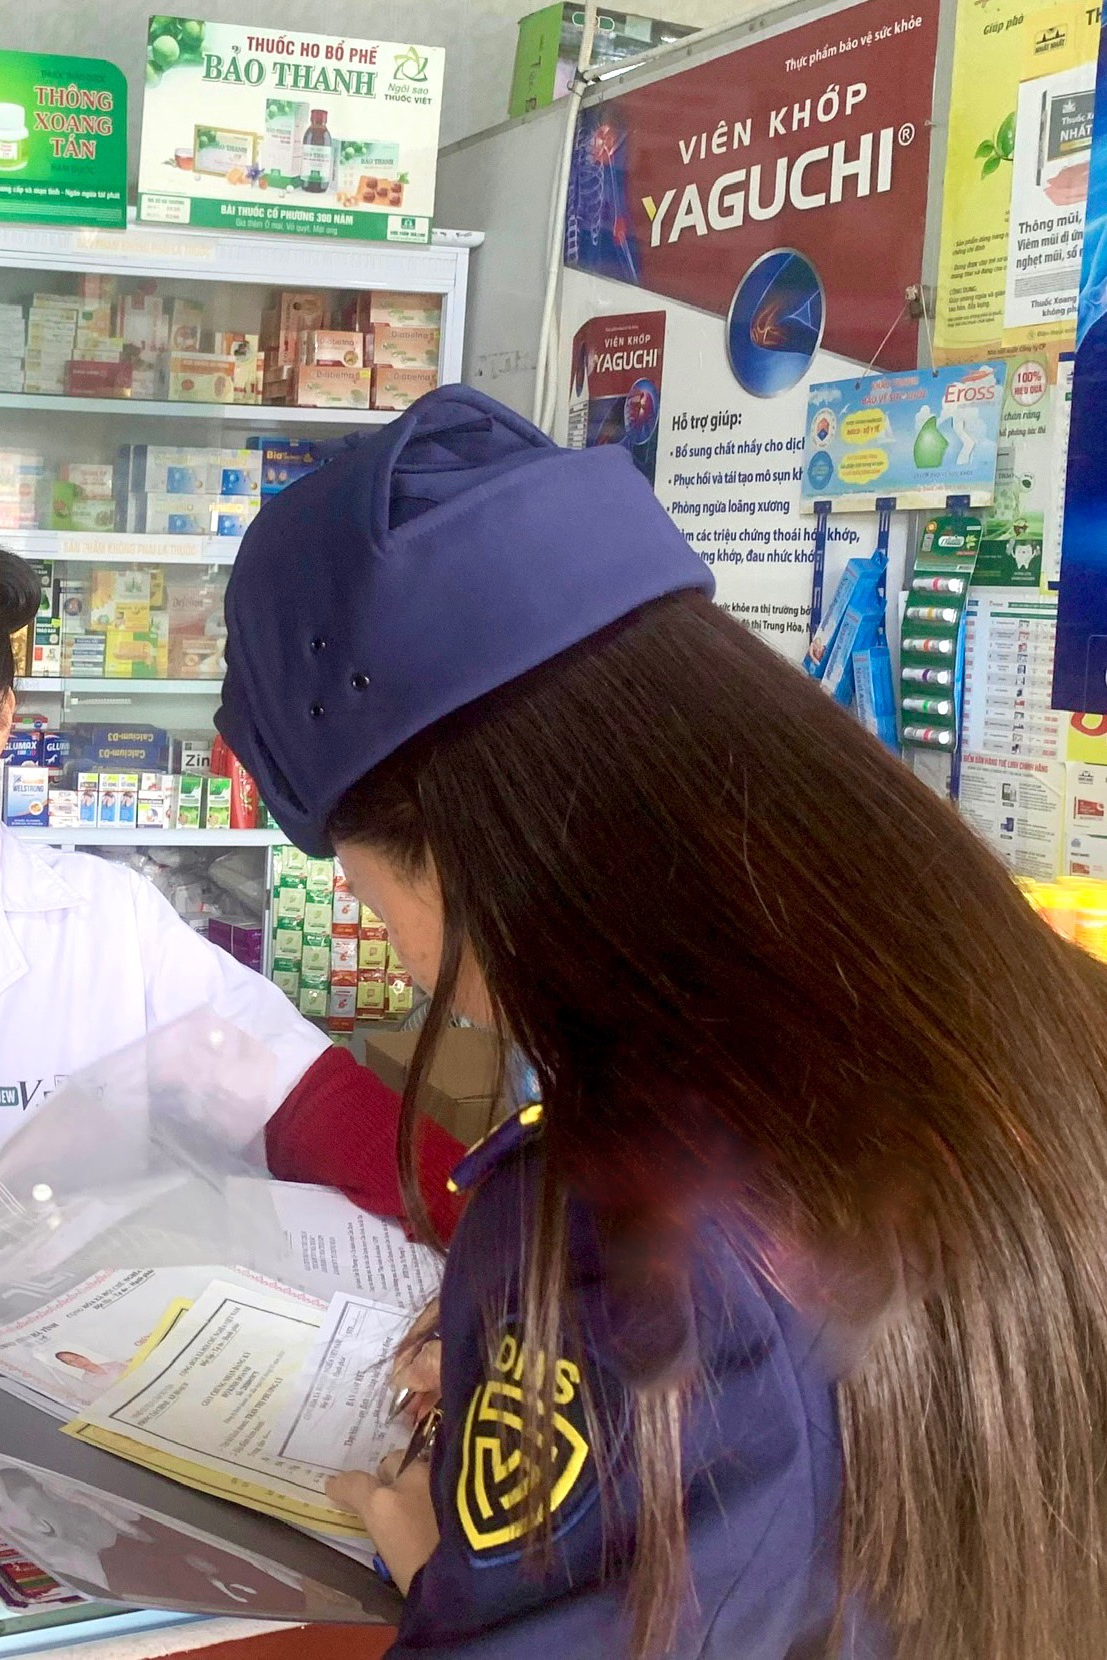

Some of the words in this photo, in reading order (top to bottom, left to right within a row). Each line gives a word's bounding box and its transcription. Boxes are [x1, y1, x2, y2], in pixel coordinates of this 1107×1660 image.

[983, 21, 1003, 35] Giúp
[247, 34, 295, 56] THUỐC
[300, 42, 320, 58] HO
[325, 40, 345, 61] BỔ
[349, 45, 380, 65] PHẾ
[785, 56, 808, 72] Thực
[809, 43, 837, 67] phẩm
[839, 37, 859, 53] bảo
[860, 30, 873, 47] vệ
[874, 25, 892, 41] sức
[894, 15, 922, 36] khỏe
[202, 46, 266, 85] BẢO
[272, 61, 378, 98] THANH
[34, 83, 113, 111] THÔNG
[388, 82, 411, 94] Ngôi
[413, 86, 429, 95] sao
[384, 94, 413, 104] THUỐC
[414, 95, 432, 106] VIỆT
[34, 112, 113, 135] XOANG
[677, 116, 752, 166] VIÊN
[768, 80, 868, 138] KHỚP
[1062, 112, 1086, 125] Thuốc
[50, 134, 96, 159] TÁN
[220, 203, 236, 216] BÀI
[237, 205, 265, 219] THUỐC
[267, 206, 279, 219] CỔ
[280, 208, 314, 222] PHƯƠNG
[316, 213, 332, 223] 300
[333, 213, 354, 226] NĂM
[1019, 216, 1053, 234] Thông
[1057, 211, 1082, 228] mũi,
[1017, 236, 1039, 251] Viêm
[1041, 232, 1059, 247] mũi
[1016, 255, 1042, 271] nghẹt
[1044, 250, 1065, 264] mũi,
[1031, 296, 1052, 309] Thuốc
[604, 335, 625, 348] VIÊN
[627, 332, 651, 346] KHỚP
[594, 348, 658, 374] YAGUCHI
[1017, 372, 1042, 383] 100%
[944, 384, 995, 403] Eross
[672, 411, 688, 432] Hỗ
[690, 413, 709, 432] trợ
[710, 411, 742, 431] giúp:
[675, 443, 689, 459] Bổ
[690, 445, 713, 461] sung
[714, 438, 735, 457] chất
[764, 439, 784, 453] cho
[673, 470, 695, 489] Phục
[696, 468, 711, 485] hồi
[712, 470, 723, 485] và
[724, 467, 740, 485] tái
[740, 471, 754, 489] tạo
[755, 467, 771, 483] mô
[773, 471, 791, 489] sụn
[671, 499, 700, 516] Phòng
[701, 501, 727, 518] ngừa
[728, 499, 756, 515] loãng
[757, 499, 790, 516] xương
[696, 529, 712, 542] các
[713, 528, 737, 543] triệu
[738, 528, 771, 546] chứng
[773, 526, 802, 543] thoái
[827, 526, 860, 546] khớp,
[717, 548, 744, 567] khớp,
[746, 549, 765, 563] đau
[766, 547, 793, 563] nhức
[732, 602, 750, 614] khỏe
[751, 605, 759, 614] ra
[760, 603, 772, 616] thị
[773, 604, 799, 618] trường
[751, 620, 762, 632] thị
[763, 621, 785, 635] Trung
[186, 754, 211, 768] Zin
